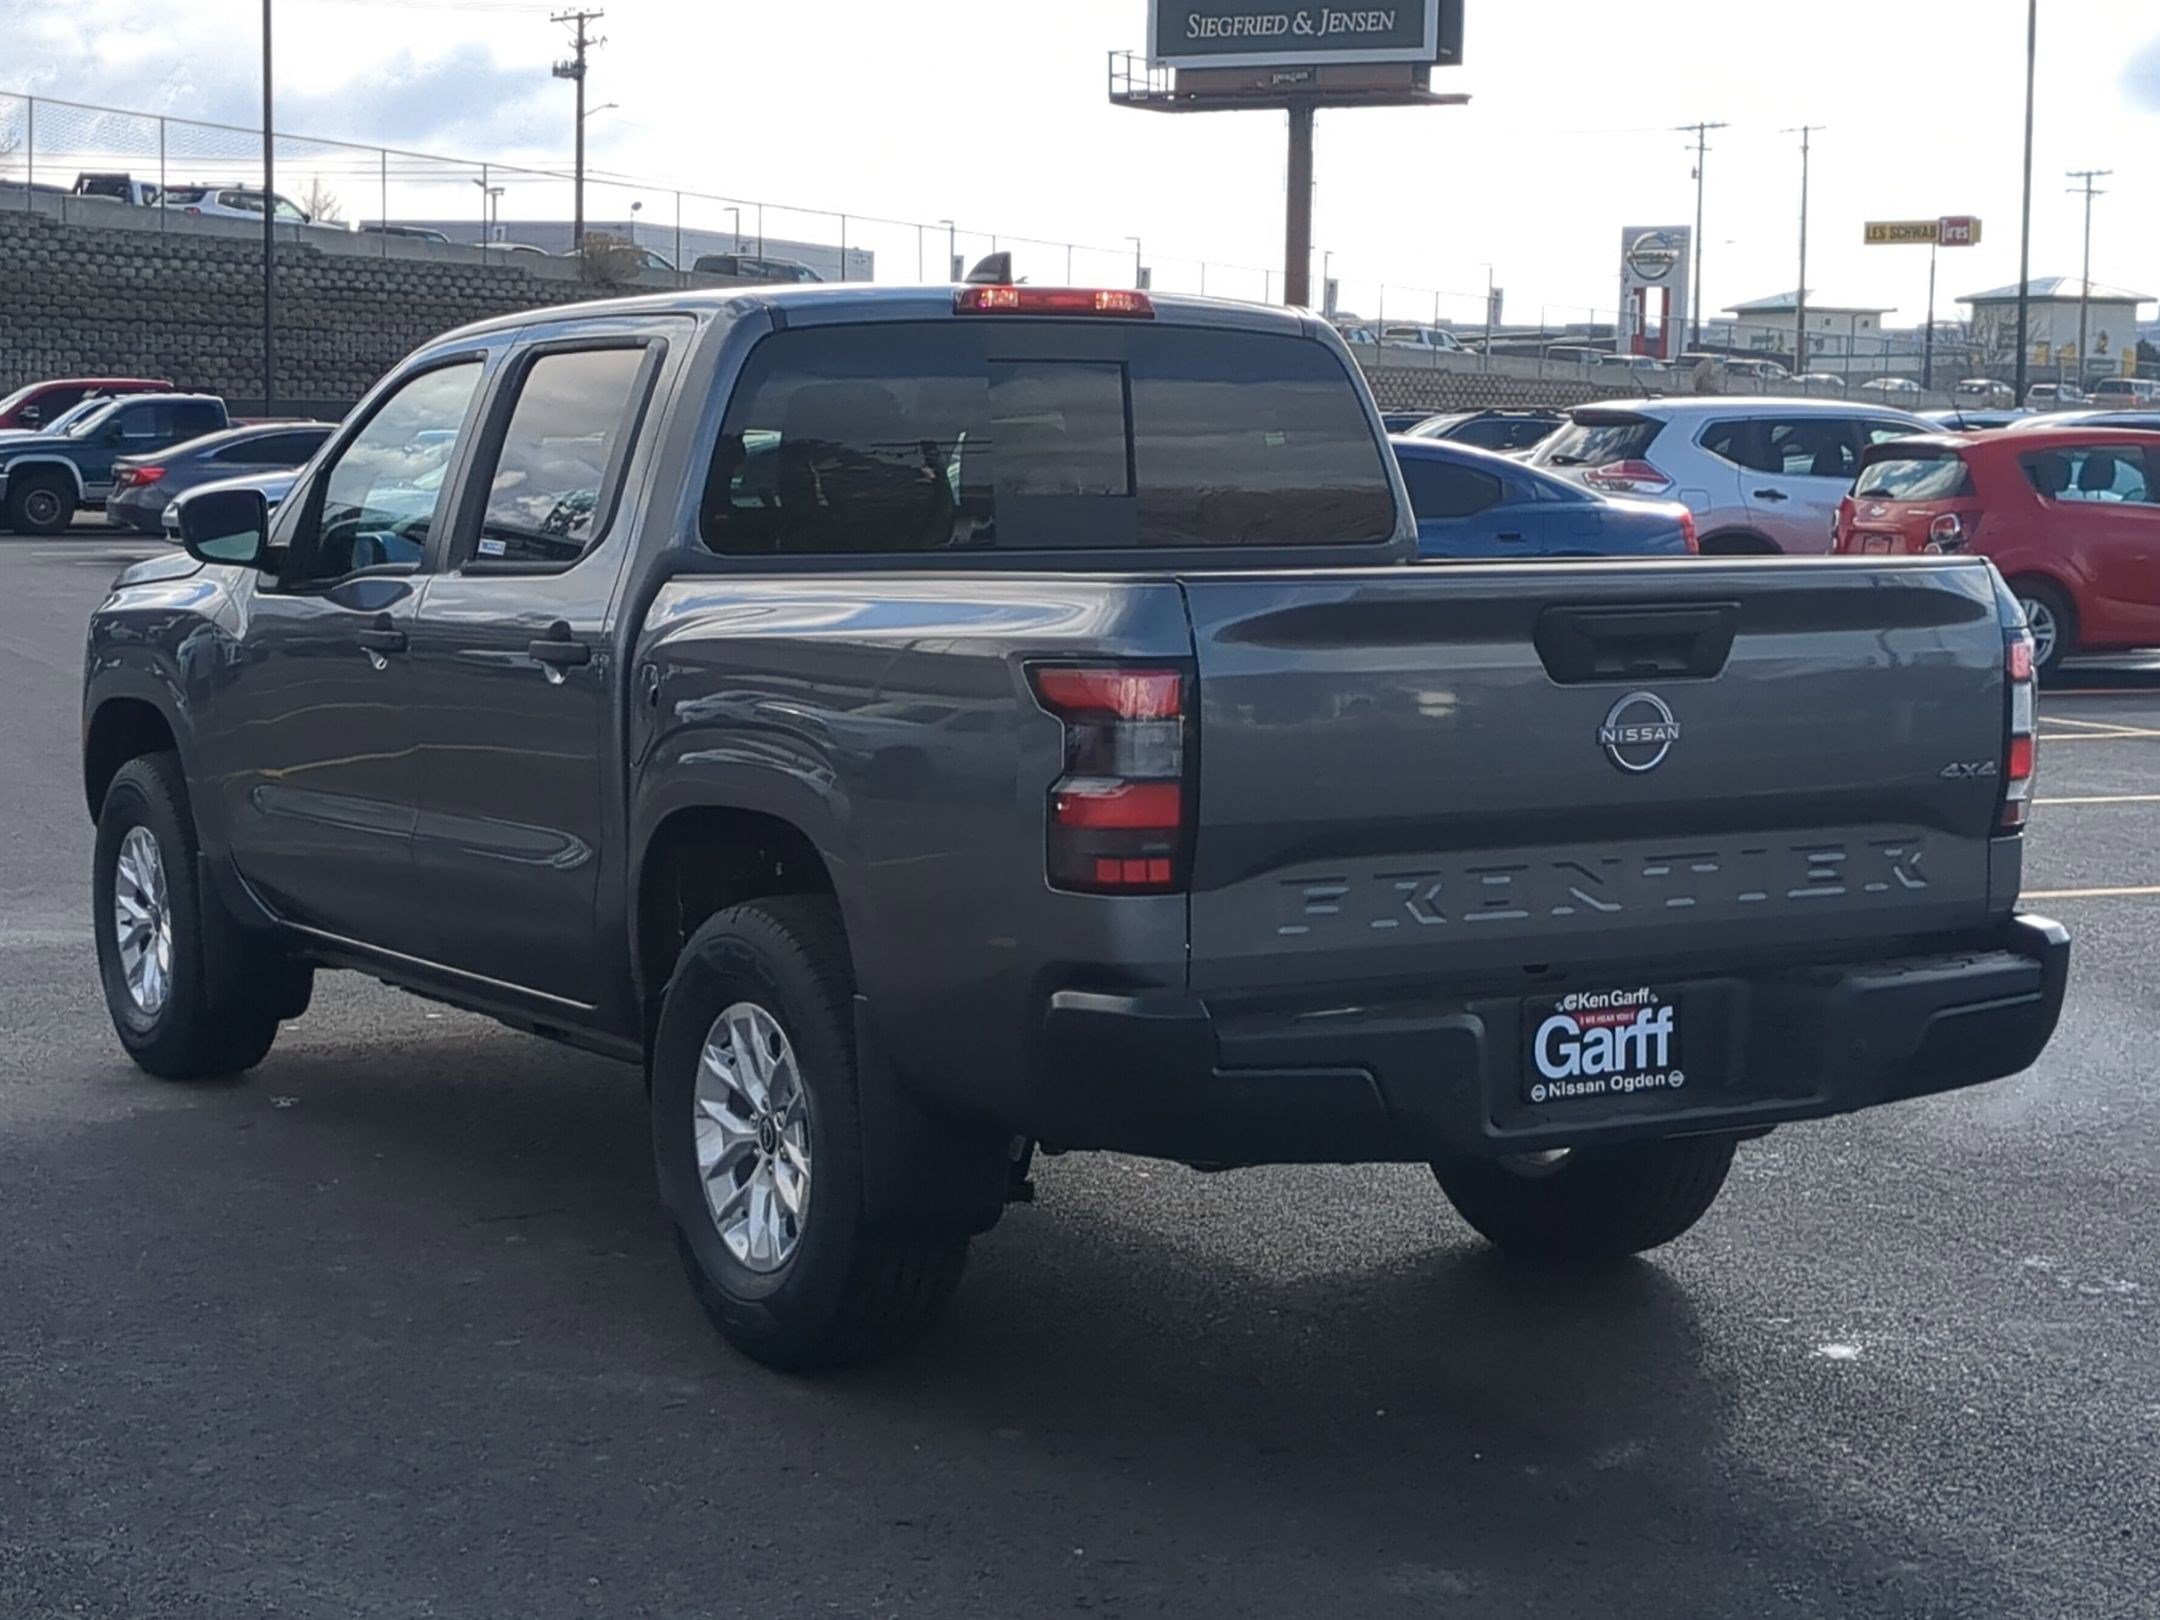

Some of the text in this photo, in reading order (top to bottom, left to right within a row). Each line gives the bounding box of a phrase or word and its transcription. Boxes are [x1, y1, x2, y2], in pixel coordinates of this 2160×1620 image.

[1186, 8, 1396, 38] SIEGFRIED & JENSEN
[1866, 226, 1886, 240] LES
[1889, 224, 1937, 240] SCHWAB
[1602, 725, 1680, 743] NISSAN
[1279, 840, 1928, 934] FRONTIER
[1578, 988, 1649, 1009] Ken Garff
[1535, 1006, 1673, 1079] Garff
[1549, 1073, 1665, 1097] Nissan Ogden
